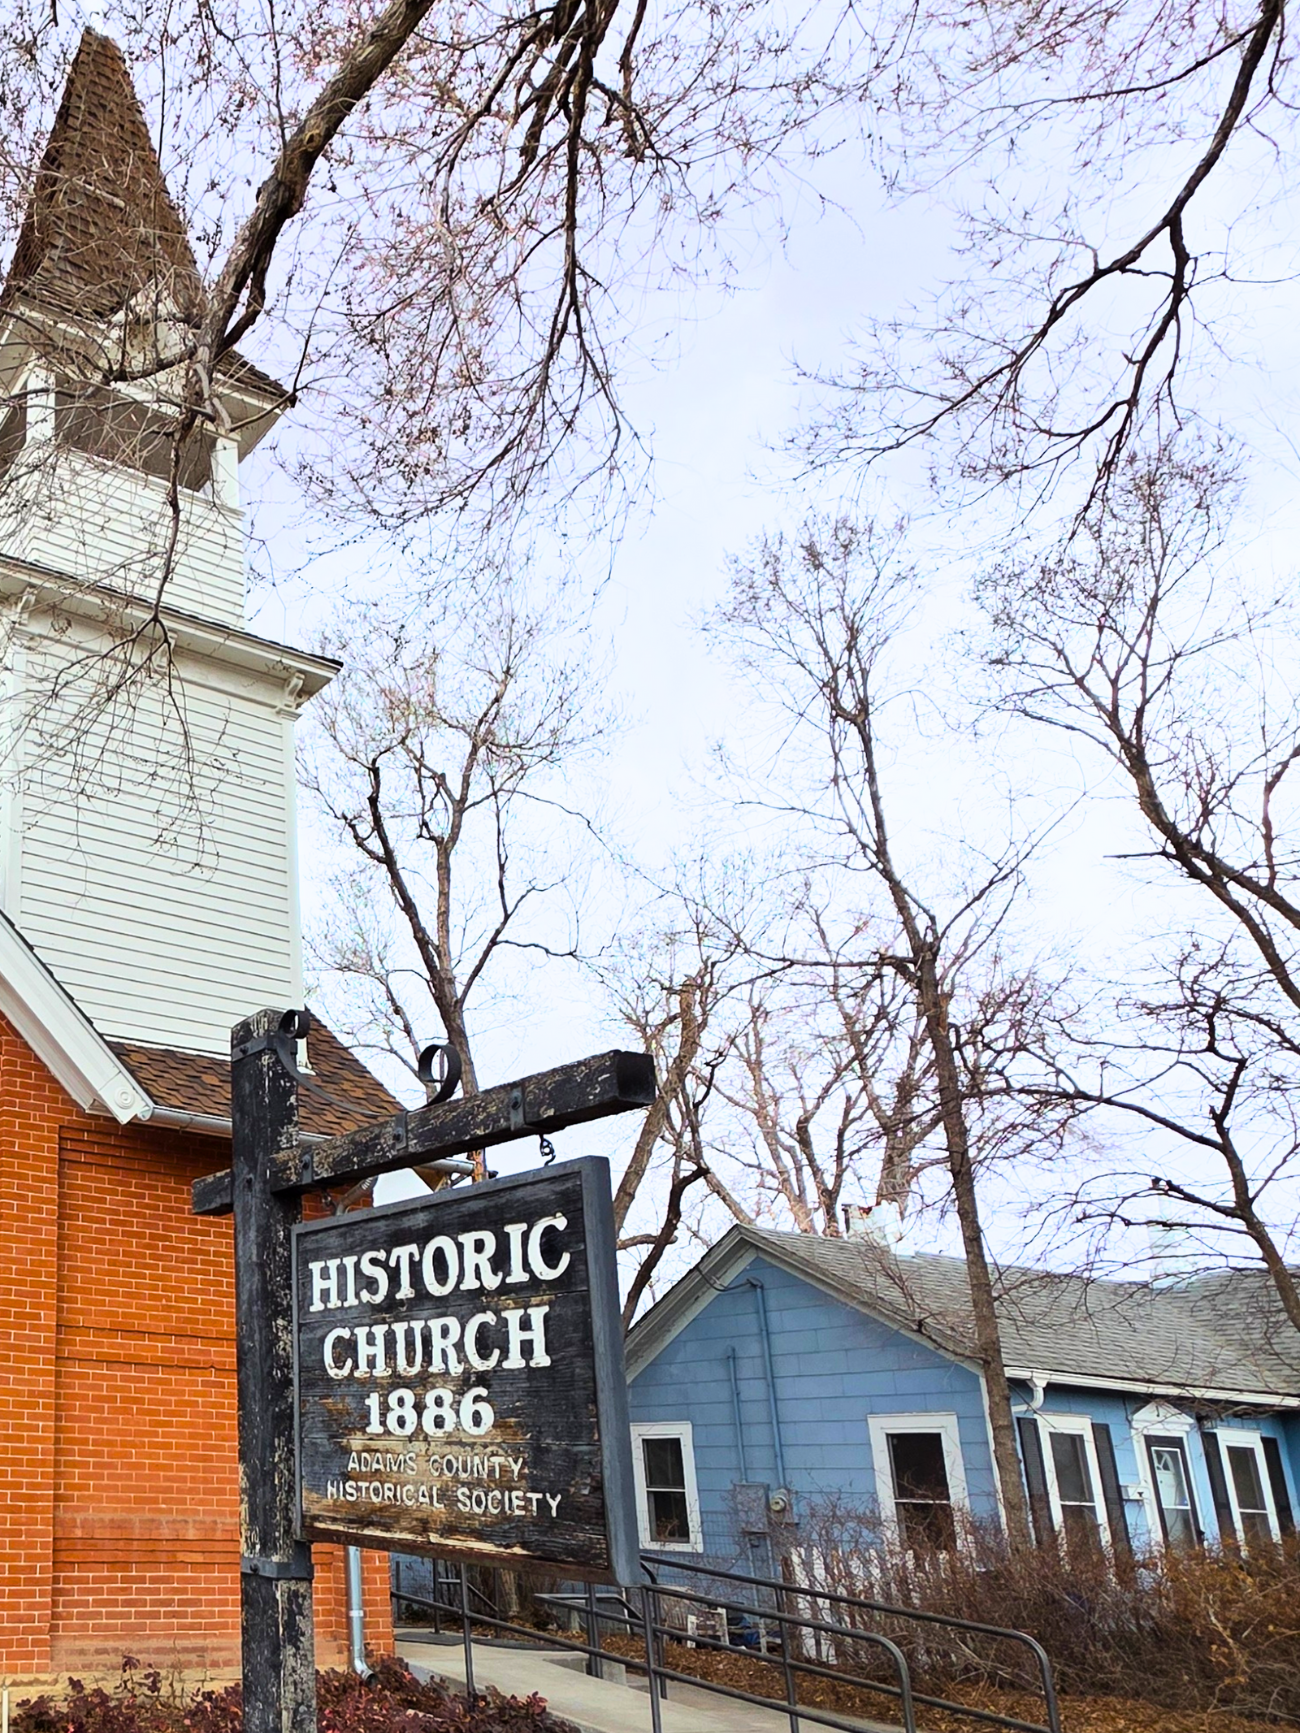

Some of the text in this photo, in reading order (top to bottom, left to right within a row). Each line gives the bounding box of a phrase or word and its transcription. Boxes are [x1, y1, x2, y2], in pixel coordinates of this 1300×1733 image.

[308, 1212, 571, 1312] HISTORIC
[323, 1305, 551, 1380] CHURCH
[364, 1386, 495, 1437] 1886
[346, 1452, 524, 1481] ADAMS COUNTY
[326, 1480, 562, 1518] HISTORICAL SOCIETY
